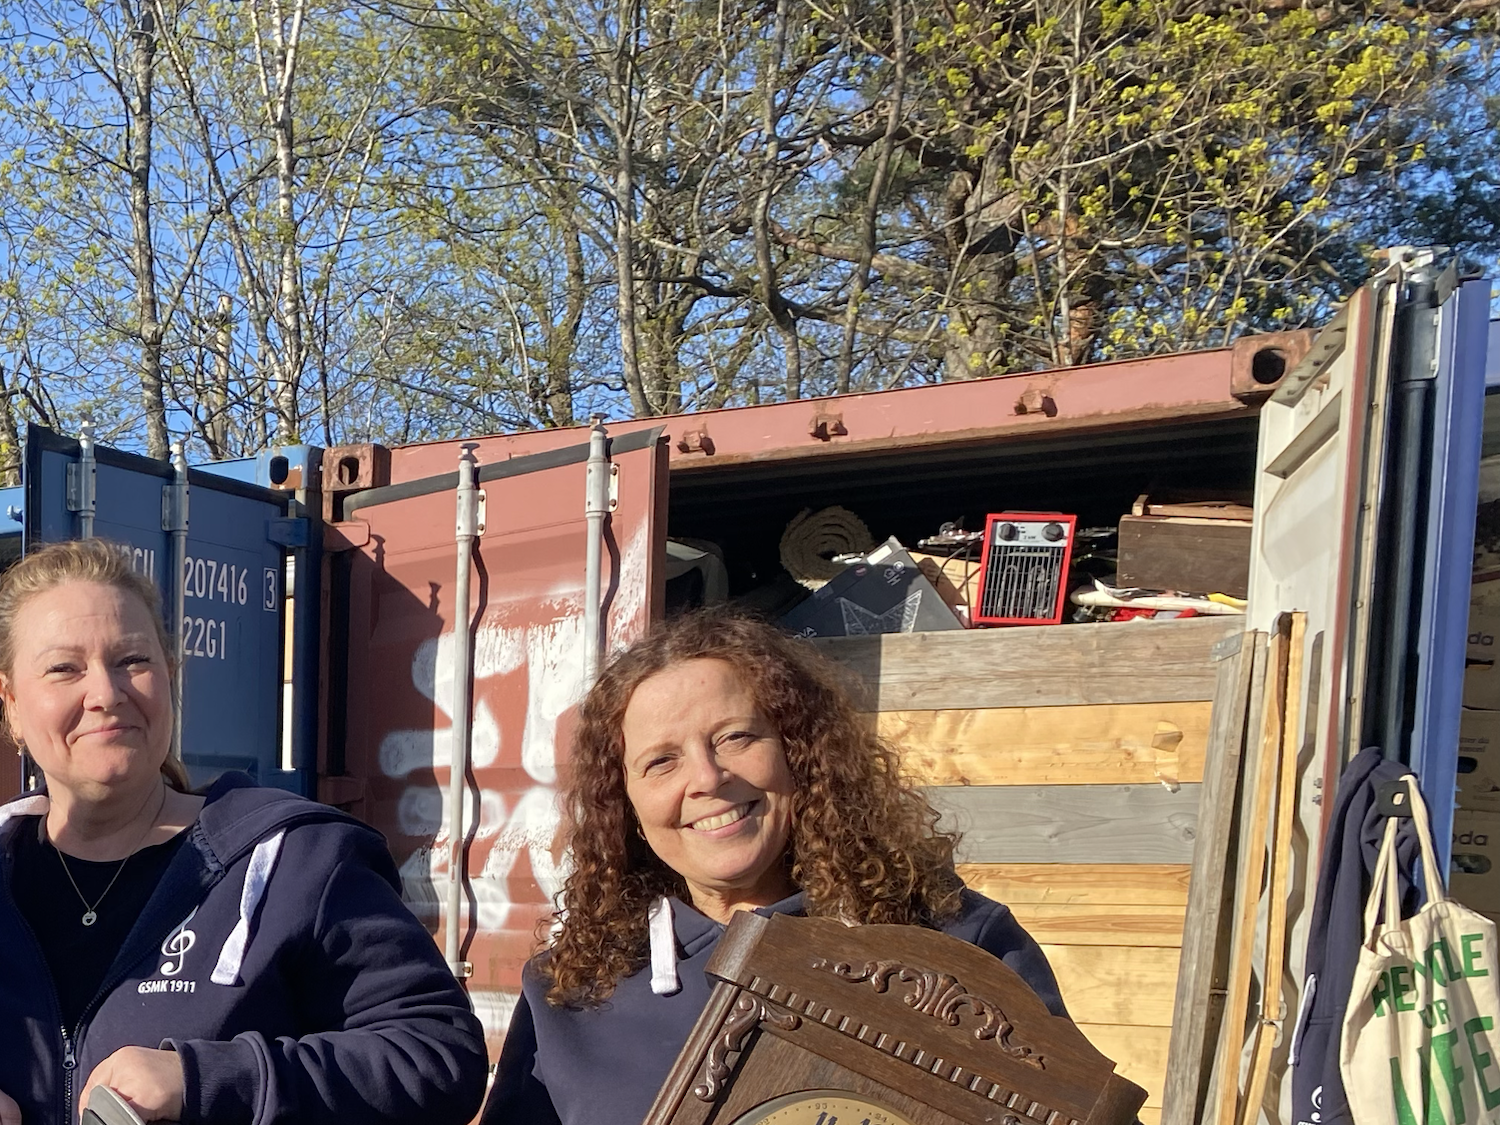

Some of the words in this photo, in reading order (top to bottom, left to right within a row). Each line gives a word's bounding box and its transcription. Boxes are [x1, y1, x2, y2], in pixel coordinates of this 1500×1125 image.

[184, 556, 248, 606] 207416
[264, 570, 276, 609] 3
[182, 615, 226, 660] 22G1
[1452, 830, 1488, 847] da
[138, 979, 168, 993] GSMK
[169, 979, 196, 993] 1911
